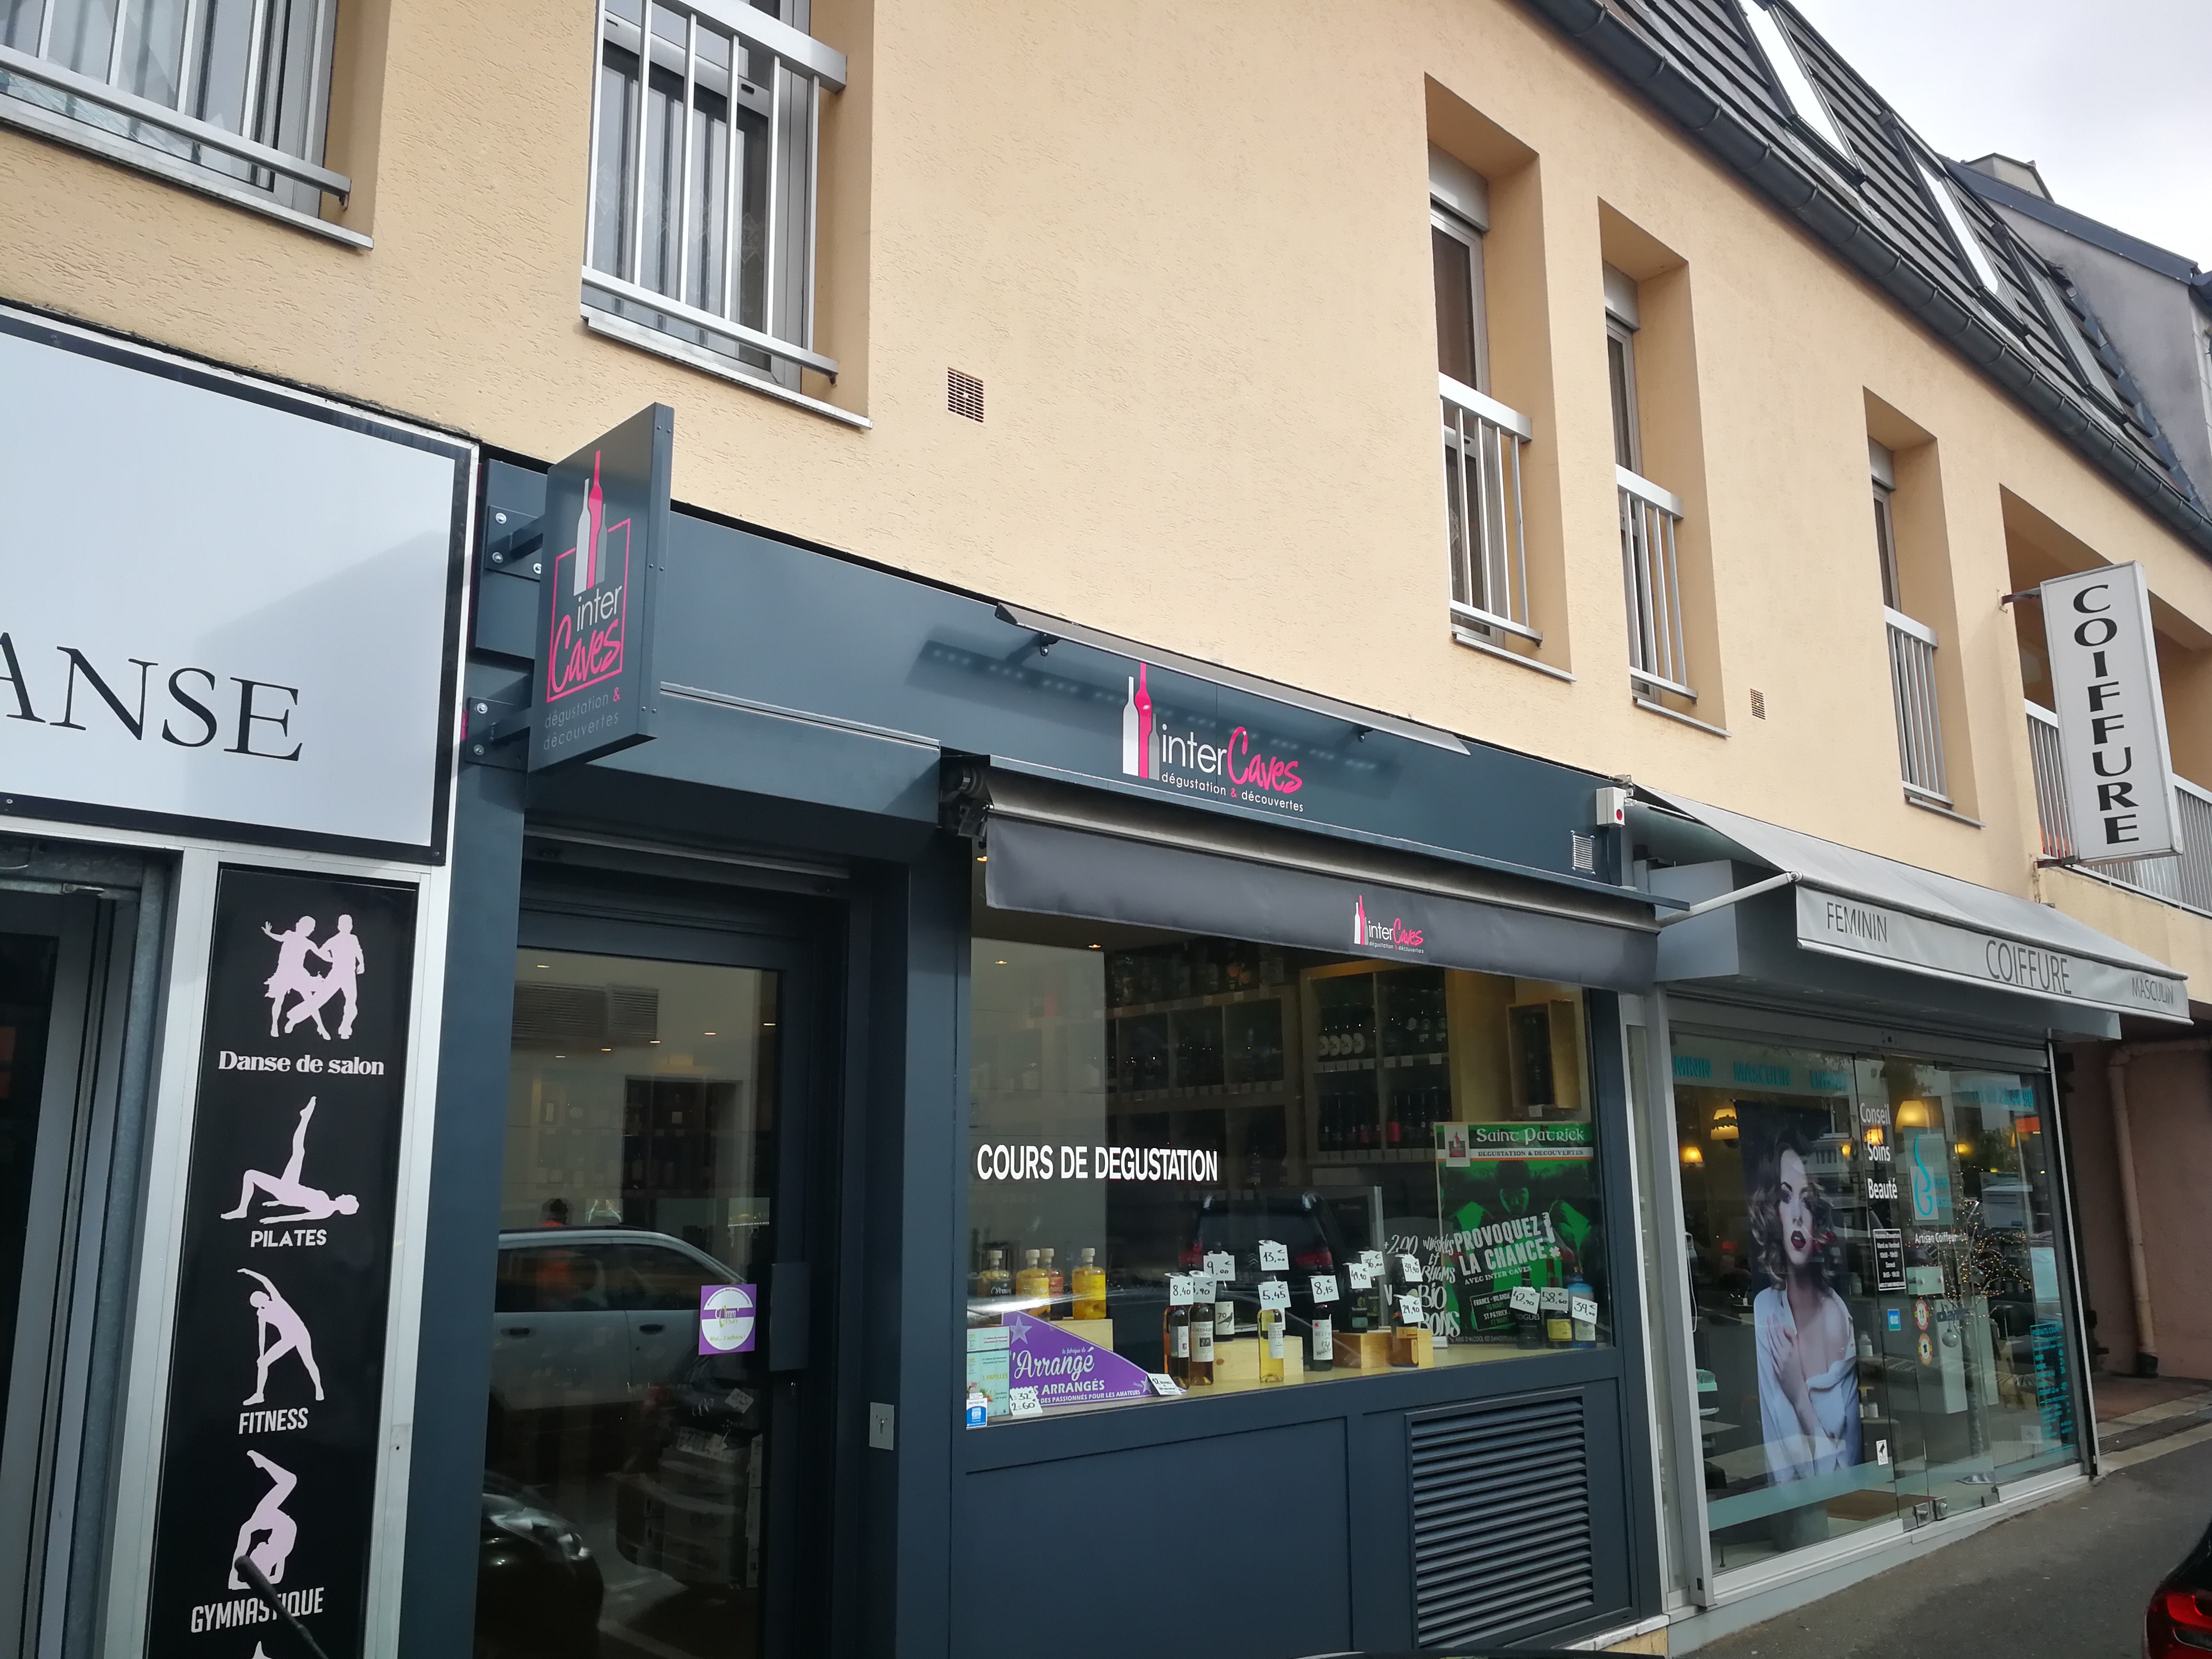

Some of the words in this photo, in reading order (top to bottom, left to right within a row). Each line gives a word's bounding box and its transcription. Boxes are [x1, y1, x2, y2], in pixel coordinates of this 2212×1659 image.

[576, 585, 623, 632] inter
[551, 614, 621, 693] Caves
[545, 693, 609, 729] dégustation
[613, 687, 621, 702] &
[2073, 584, 2140, 845] COIFFURE
[544, 712, 619, 750] découvertes
[1161, 772, 1226, 796] dégustation
[1230, 788, 1237, 798] &
[1241, 790, 1304, 812] découvertes
[1827, 901, 1888, 943] FEMININ
[1986, 939, 2072, 995] COIFFURE
[2132, 977, 2174, 1004] MASCULIN
[218, 1050, 290, 1073] Danse
[296, 1054, 323, 1074] de
[327, 1056, 385, 1075] salon
[1733, 1061, 1791, 1086] MASCULIN
[1860, 1102, 1891, 1125] Conseil
[1476, 1128, 1519, 1142] Saint
[977, 1144, 1054, 1180] COURS
[1061, 1146, 1088, 1179] DE
[1095, 1146, 1217, 1181] DEGUSTATION
[1867, 1140, 1891, 1161] Soins
[1867, 1177, 1898, 1200] Beauté
[250, 1229, 327, 1248] PILATES
[1453, 1215, 1541, 1253] PROVOQUEZ
[1915, 1233, 1935, 1244] Artisan
[1935, 1231, 1957, 1243] Coiffeur
[1458, 1252, 1481, 1277] LA
[1485, 1238, 1548, 1270] CHANCE
[1465, 1275, 1484, 1285] AVEC
[1485, 1270, 1508, 1280] INTER
[1508, 1265, 1532, 1275] CAVES
[1473, 1297, 1491, 1307] FRANCE
[1041, 1378, 1105, 1395] ARRANGÉS
[1052, 1394, 1088, 1403] PASSIONNÉS
[239, 1407, 309, 1435] FITNESS
